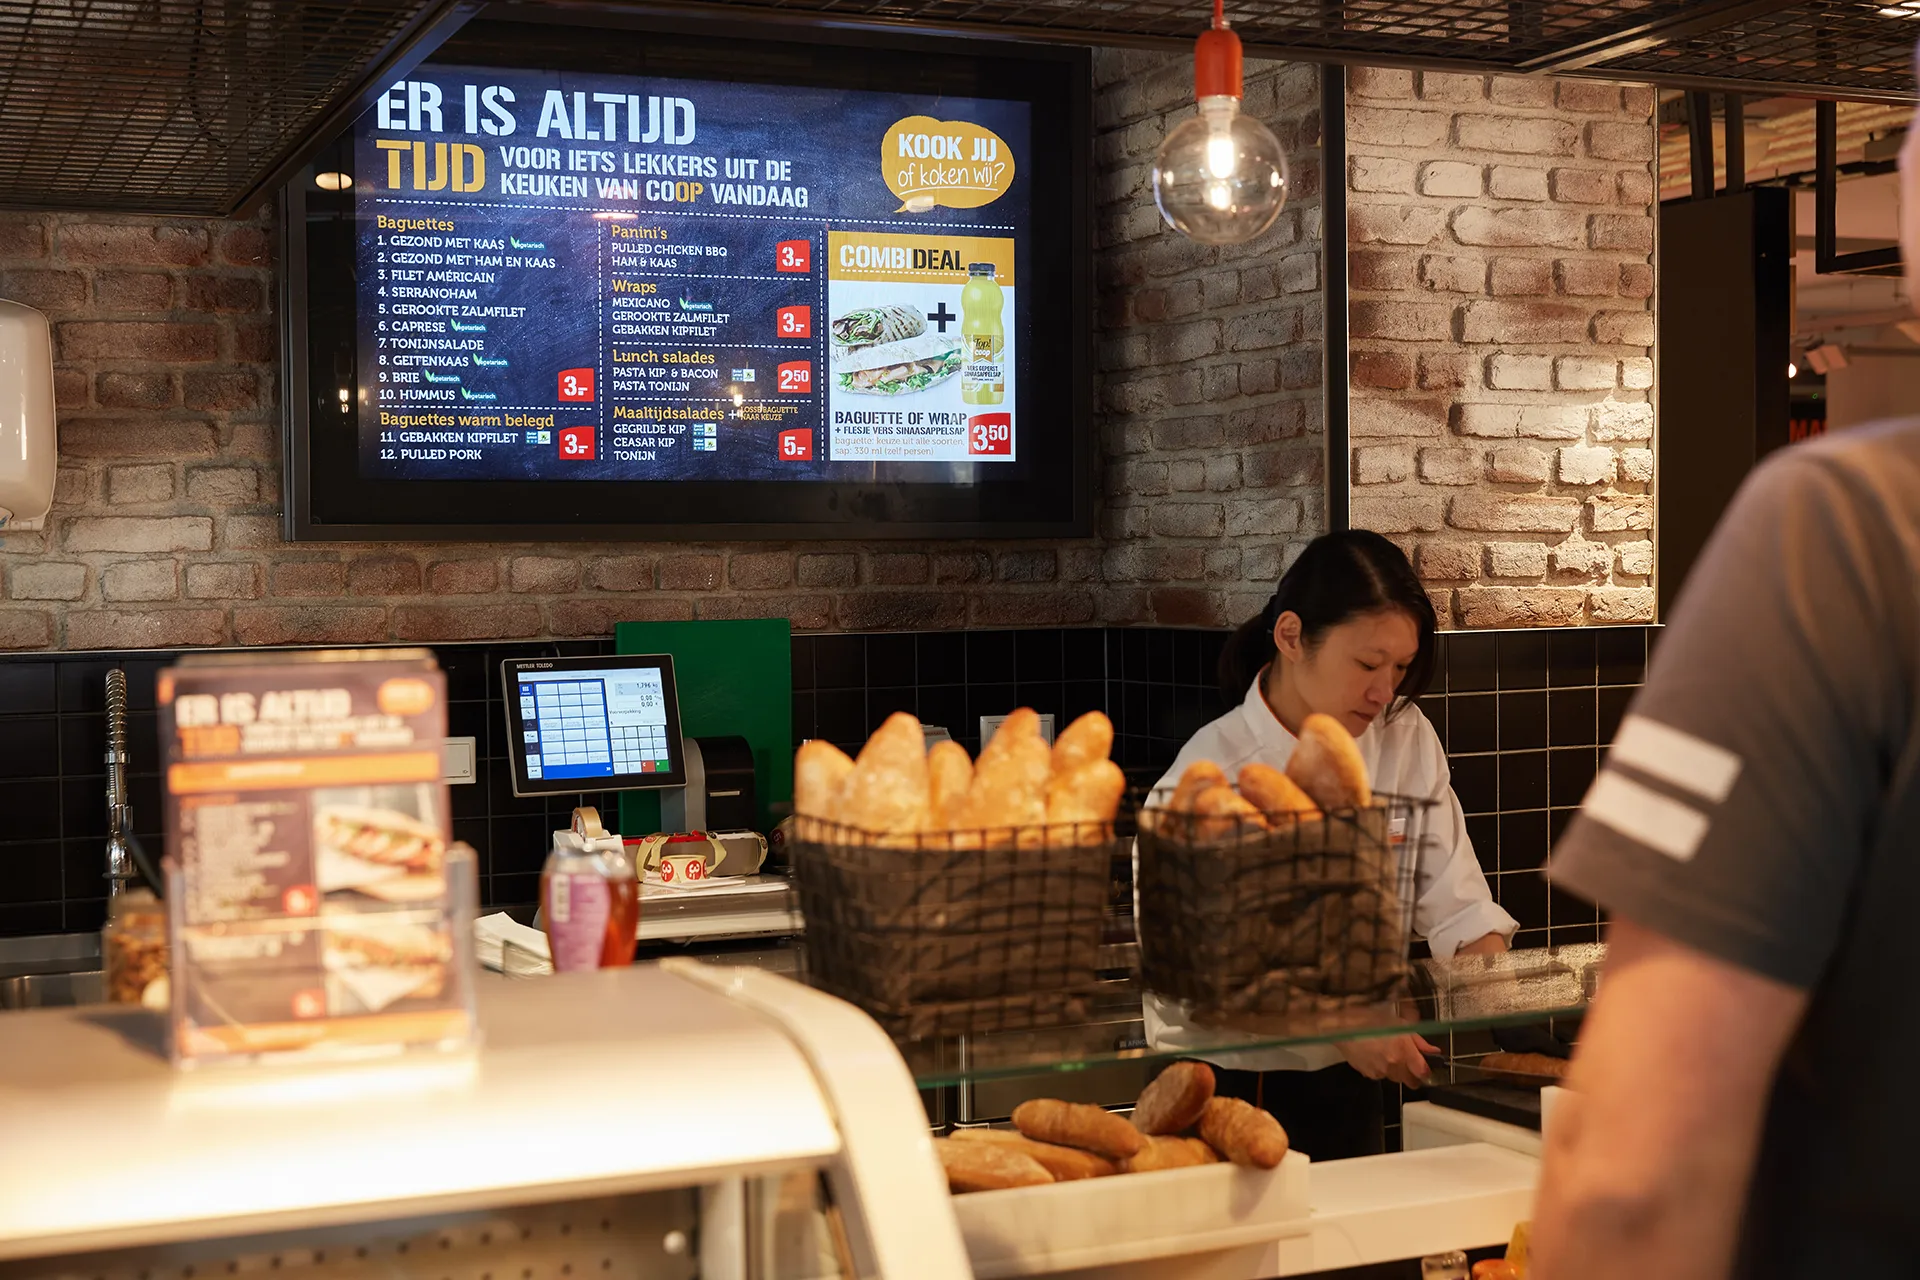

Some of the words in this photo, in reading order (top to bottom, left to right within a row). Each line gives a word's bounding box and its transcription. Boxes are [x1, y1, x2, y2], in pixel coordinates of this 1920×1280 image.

[376, 81, 443, 132] ER
[464, 85, 516, 136] IS
[536, 90, 695, 145] ALTIJD
[899, 133, 962, 161] KOOK
[971, 138, 996, 162] JIJ
[376, 140, 485, 193] TIJD
[500, 146, 560, 170] VOOR
[568, 150, 615, 173] IETS
[624, 152, 717, 178] LEKKERS
[725, 158, 756, 180] UIT
[766, 160, 791, 181] DE
[898, 166, 914, 188] of
[920, 165, 969, 185] koken
[974, 163, 1005, 185] wij?
[501, 173, 587, 197] KEUKEN
[595, 177, 638, 200] VAN
[646, 180, 703, 203] COOP
[711, 185, 808, 208] VANDAAG
[377, 215, 454, 232] Baguettes
[612, 225, 667, 239] Panini's
[377, 236, 387, 246] 1.
[391, 236, 442, 248] GEZOND
[445, 238, 471, 249] MET
[474, 239, 505, 250] KAAS
[612, 243, 652, 253] PULLED
[654, 245, 702, 255] CHICKEN
[706, 246, 727, 256] BBQ
[378, 252, 388, 263] 2.
[392, 253, 442, 265] GEZOND
[446, 255, 473, 265] MET
[474, 256, 501, 267] HAM
[506, 257, 521, 267] EN
[525, 258, 556, 268] KAAS
[612, 256, 637, 267] HAM
[639, 258, 647, 266] &
[649, 258, 677, 268] KAAS
[840, 245, 965, 271] COMBIDEAL
[378, 270, 388, 280] 3.
[392, 270, 424, 281] FILET
[427, 270, 495, 283] AMÉRICAIN
[378, 288, 388, 297] 4.
[392, 288, 477, 299] SERRANOHAM
[612, 280, 656, 295] Wraps
[612, 298, 670, 308] MEXICANO
[379, 304, 388, 314] 5.
[392, 305, 458, 316] GEROOKTE
[462, 306, 526, 318] ZALMFILET
[612, 311, 671, 321] GEROOKTE
[673, 313, 729, 323] ZALMFILET
[379, 321, 388, 331] 6.
[392, 322, 446, 333] CAPRESE
[613, 325, 669, 335] GEBAKKEN
[672, 326, 717, 336] KIPFILET
[379, 338, 387, 348] 7.
[390, 339, 484, 350] TONIJNSALADE
[379, 355, 389, 365] 8.
[393, 356, 469, 367] GEITENKAAS
[613, 350, 658, 363] Lunch
[663, 351, 714, 364] salades
[379, 372, 389, 382] 9.
[393, 373, 419, 383] BRIE
[613, 367, 646, 377] PASTA
[649, 368, 665, 378] KIP
[671, 369, 678, 378] &
[682, 369, 718, 378] BACON
[613, 381, 646, 391] PASTA
[648, 381, 690, 391] TONIJN
[379, 389, 396, 400] 10.
[400, 390, 455, 400] HUMMUS
[614, 406, 724, 421] Maaltijdsalades
[835, 412, 902, 424] BAGUETTE
[908, 412, 923, 424] OF
[929, 413, 967, 425] WRAP
[380, 412, 454, 428] Baguettes
[458, 415, 501, 426] warm
[505, 414, 554, 430] belegd
[614, 424, 666, 434] GEGRILDE
[669, 424, 686, 434] KIP
[844, 426, 870, 434] FLESJE
[896, 427, 965, 435] SINAASAPPELSAP
[380, 432, 396, 442] 11.
[400, 433, 464, 443] GEBAKKEN
[467, 433, 518, 443] KIPFILET
[614, 438, 655, 447] CEASAR
[658, 438, 675, 447] KIP
[835, 437, 873, 445] baguette:
[380, 449, 397, 460] 12.
[401, 450, 447, 460] PULLED
[450, 450, 482, 460] PORK
[614, 451, 655, 460] TONIJN
